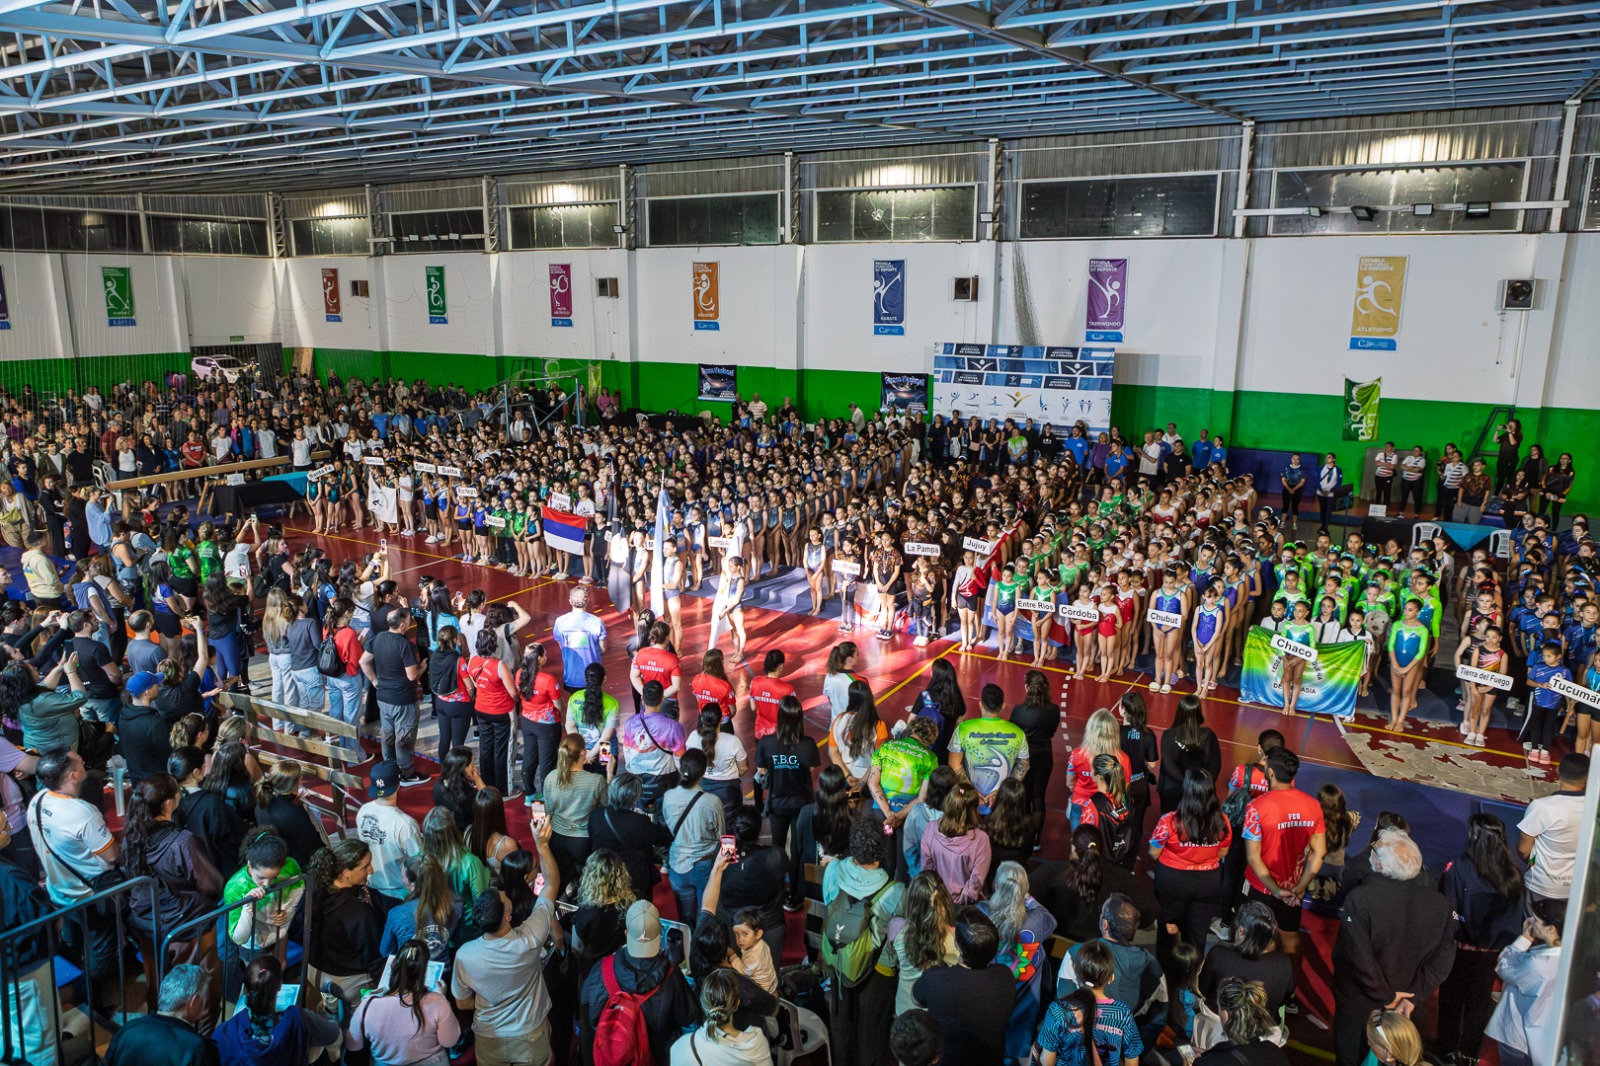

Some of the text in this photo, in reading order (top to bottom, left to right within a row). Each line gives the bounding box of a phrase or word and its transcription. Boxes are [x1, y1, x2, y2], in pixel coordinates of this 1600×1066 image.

[308, 468, 325, 478] Santa
[917, 545, 939, 553] Pampa
[967, 540, 986, 551] Jujuy
[1017, 600, 1036, 609] Entre
[1061, 606, 1097, 620] Córdoba
[1150, 612, 1178, 624] Chubut
[1277, 638, 1312, 658] Chaco
[1460, 667, 1510, 687] Tierra del Fuego
[1128, 731, 1140, 740] FBG
[772, 754, 800, 765] F.B.G.
[1278, 821, 1314, 830] ENTRENADOR
